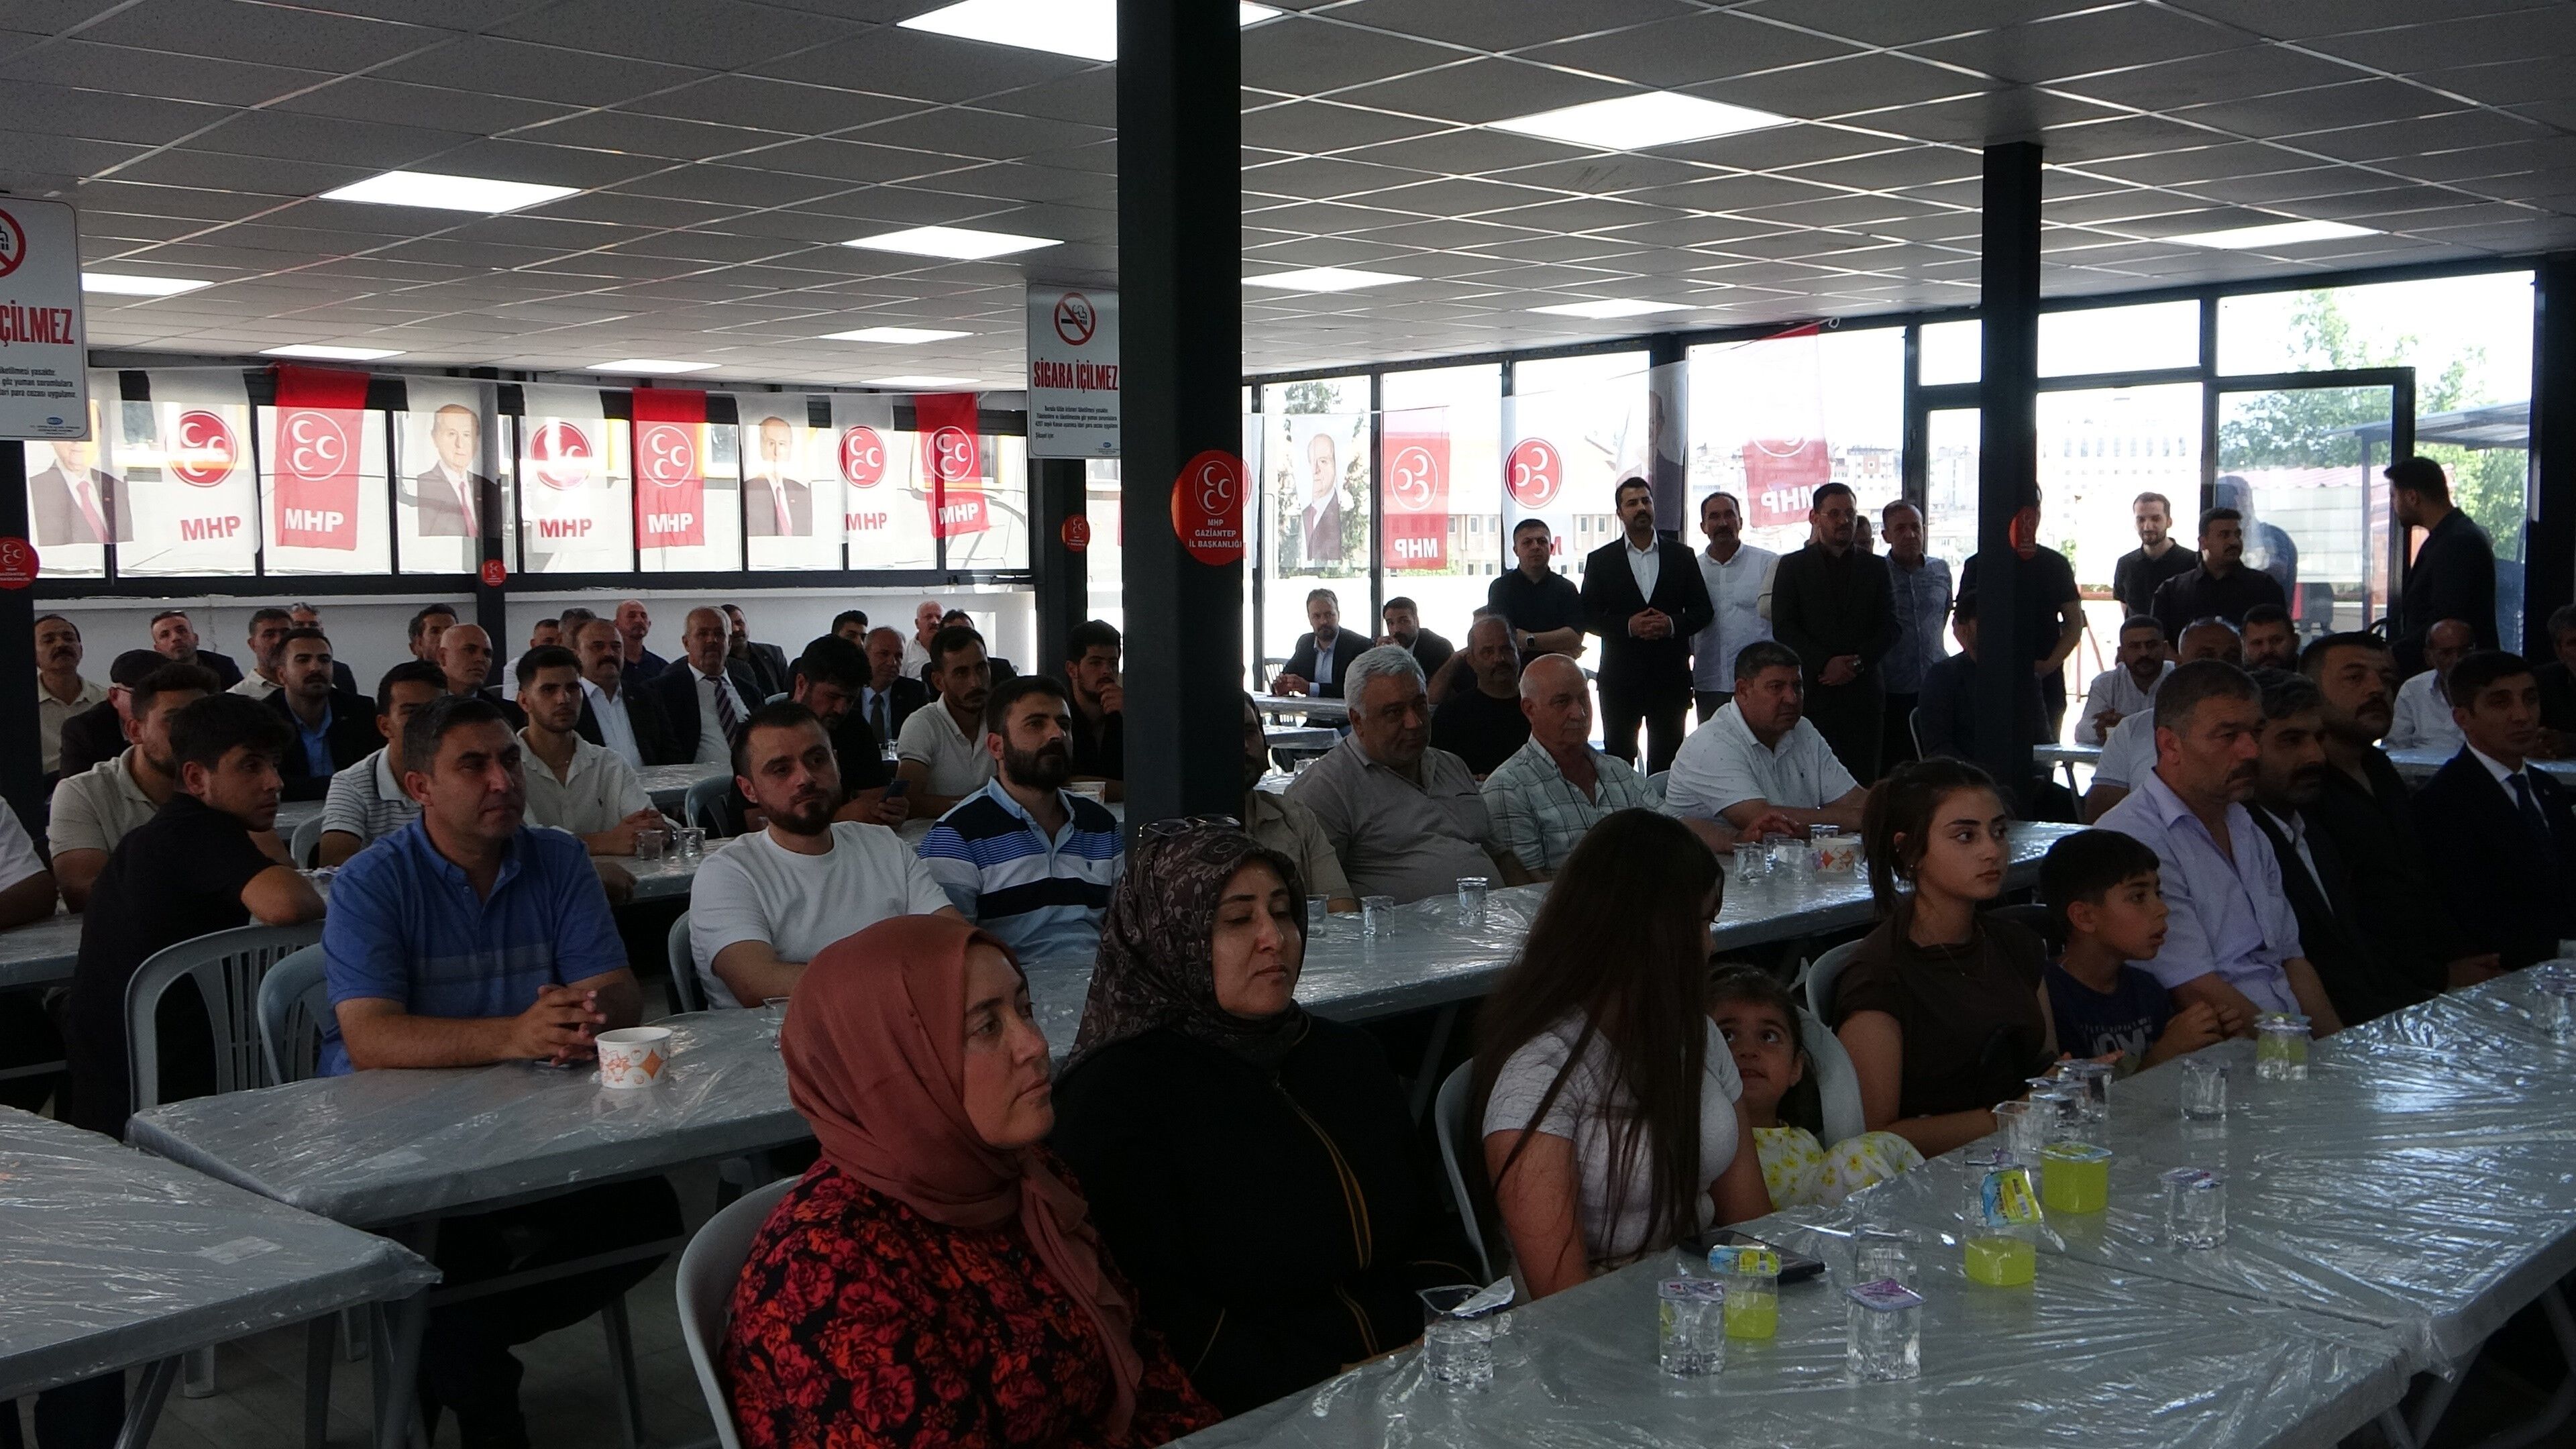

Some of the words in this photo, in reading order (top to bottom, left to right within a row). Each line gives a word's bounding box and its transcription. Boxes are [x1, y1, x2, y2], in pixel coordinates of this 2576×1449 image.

[1034, 358, 1073, 388] SİGARA
[1076, 359, 1118, 393] İÇİLMEZ
[284, 508, 344, 532] MHP
[647, 513, 694, 534] MHP
[845, 513, 887, 531] MHP
[938, 502, 979, 525] MHP
[180, 516, 241, 541] MHP
[539, 519, 592, 538] MHP
[1195, 528, 1236, 537] GAZİANTEP
[1189, 539, 1196, 547] İL
[1197, 539, 1243, 549] BAŞKANLIĞI
